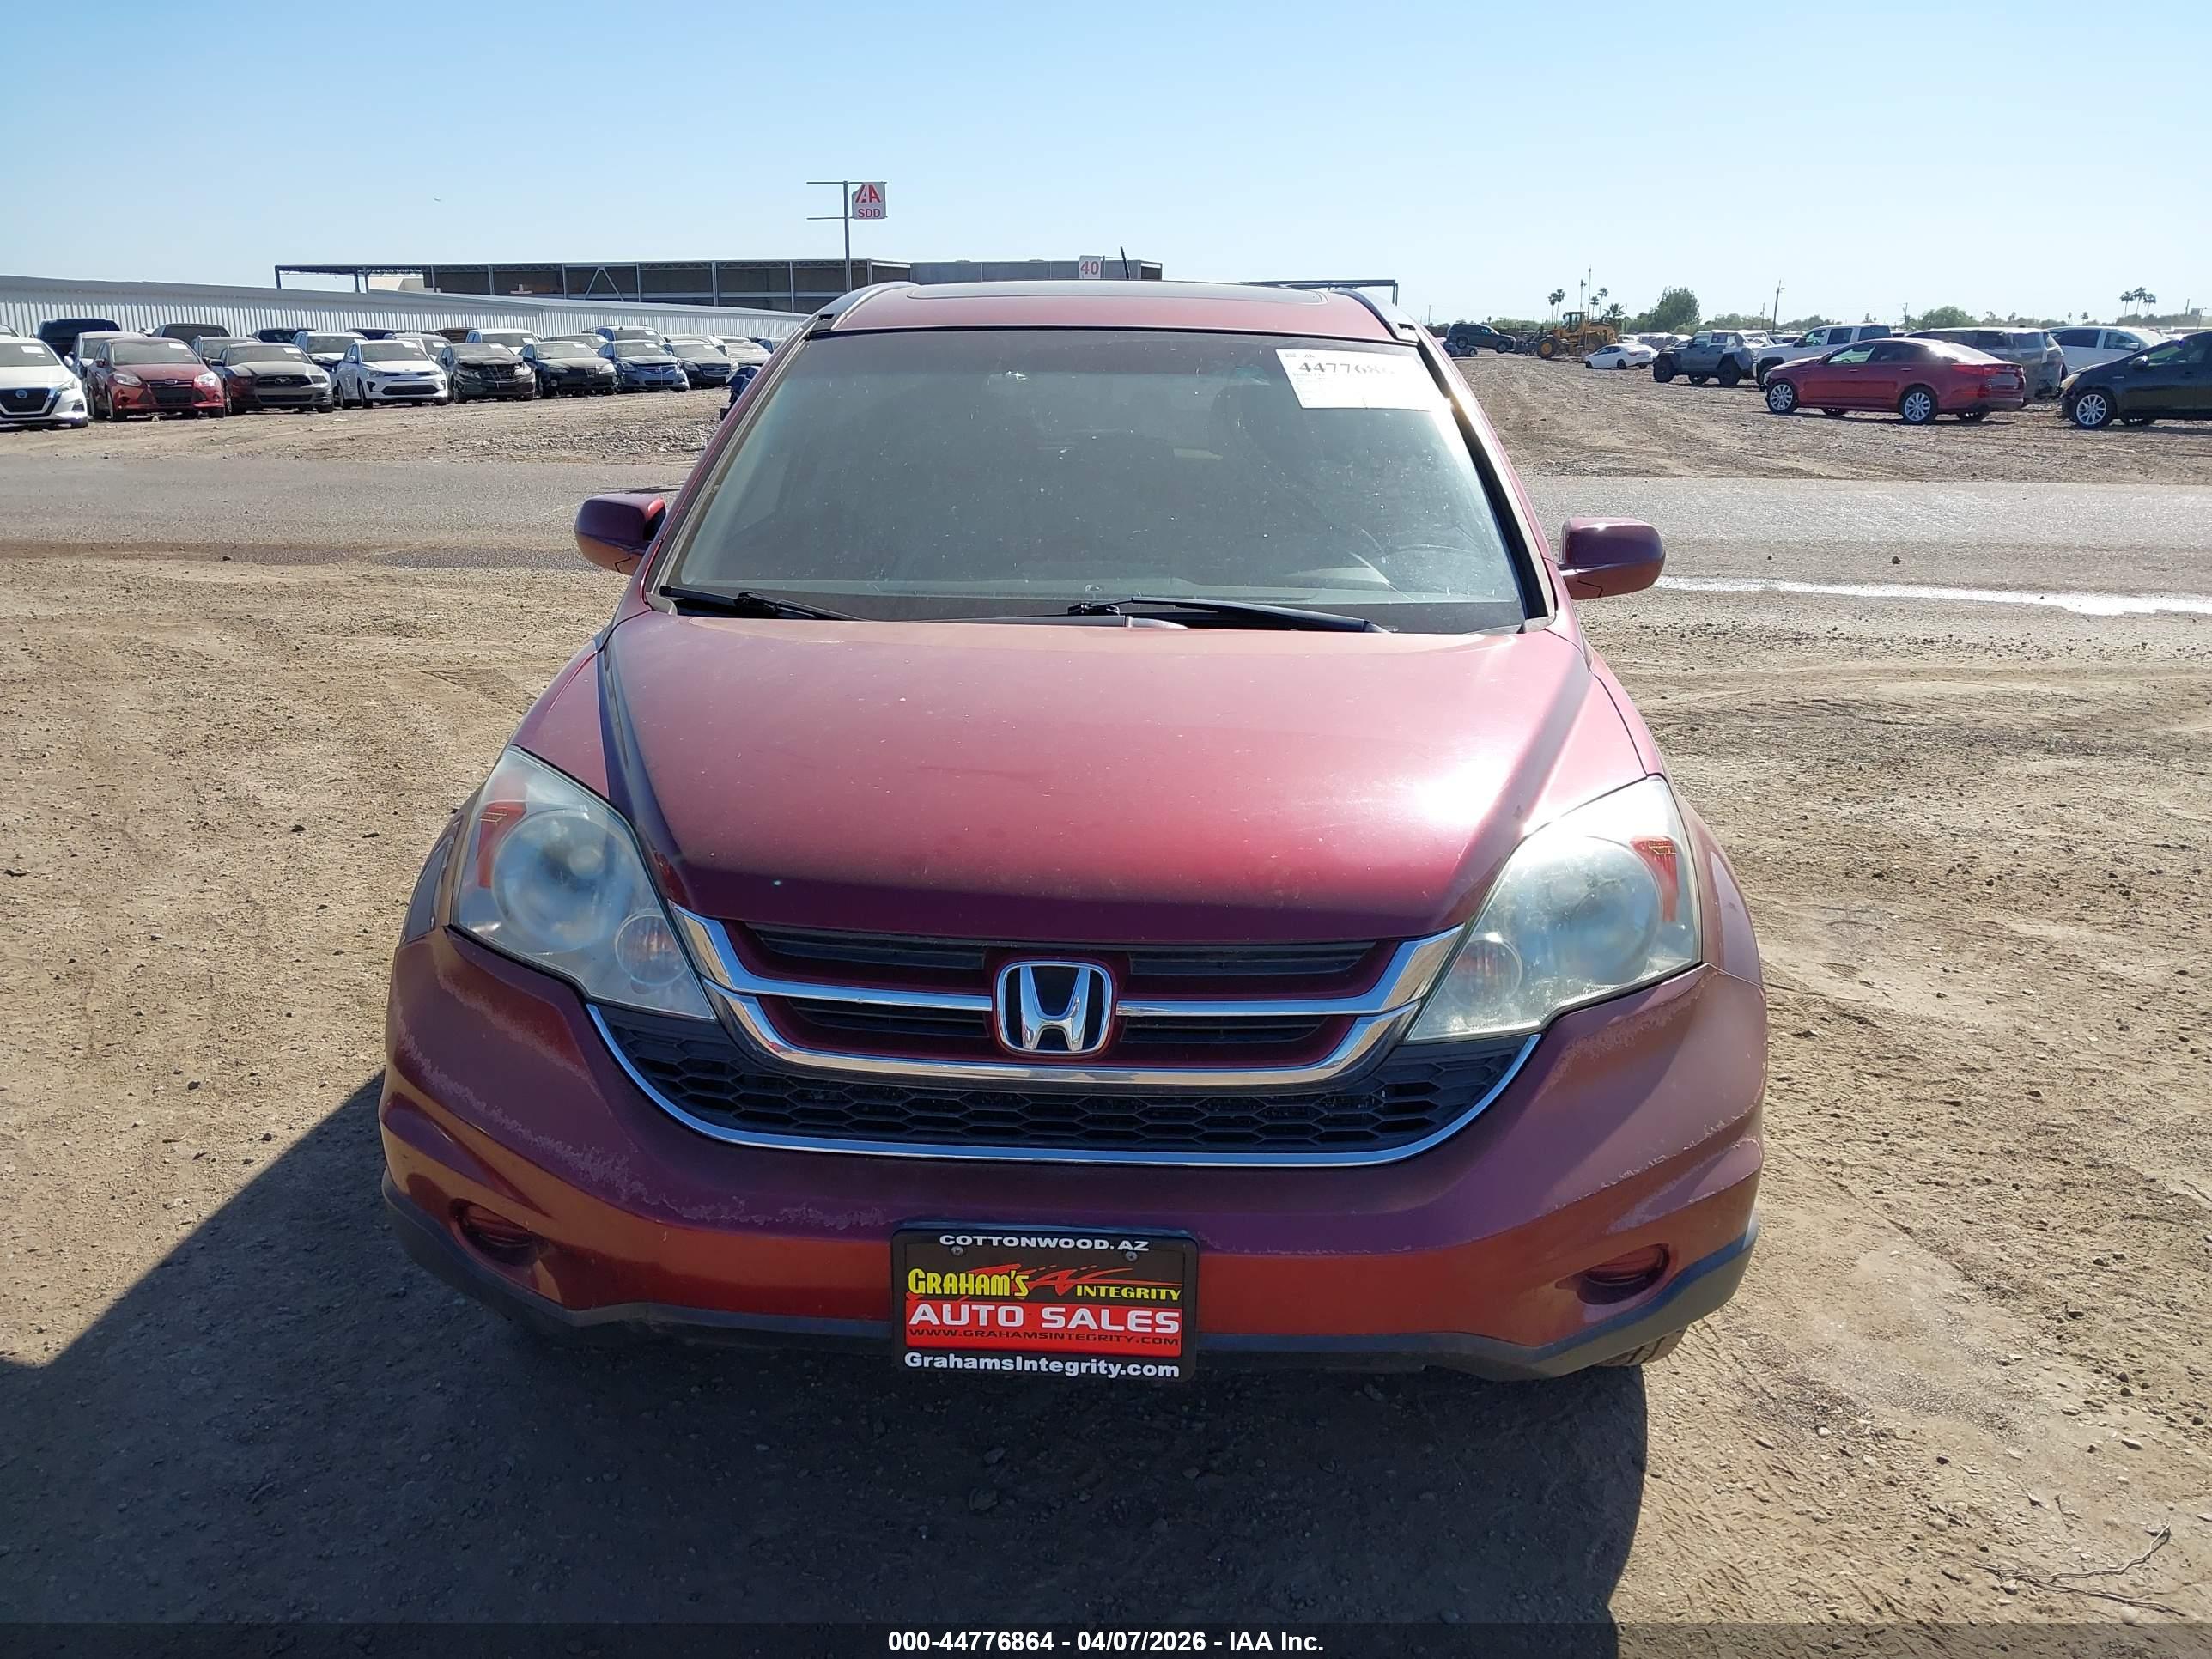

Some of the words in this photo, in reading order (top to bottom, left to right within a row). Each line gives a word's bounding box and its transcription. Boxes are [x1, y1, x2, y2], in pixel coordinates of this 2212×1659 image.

[858, 208, 881, 218] SDD
[1080, 260, 1099, 276] 40
[1075, 1285, 1182, 1301] INTEGRITY
[908, 1303, 1024, 1327] AUTO
[1042, 1307, 1181, 1334] SALES
[908, 1328, 1180, 1346] WWW.GRAHAMSINTEGRITY.COM
[904, 1352, 1181, 1378] GrahamsIntegrity.com
